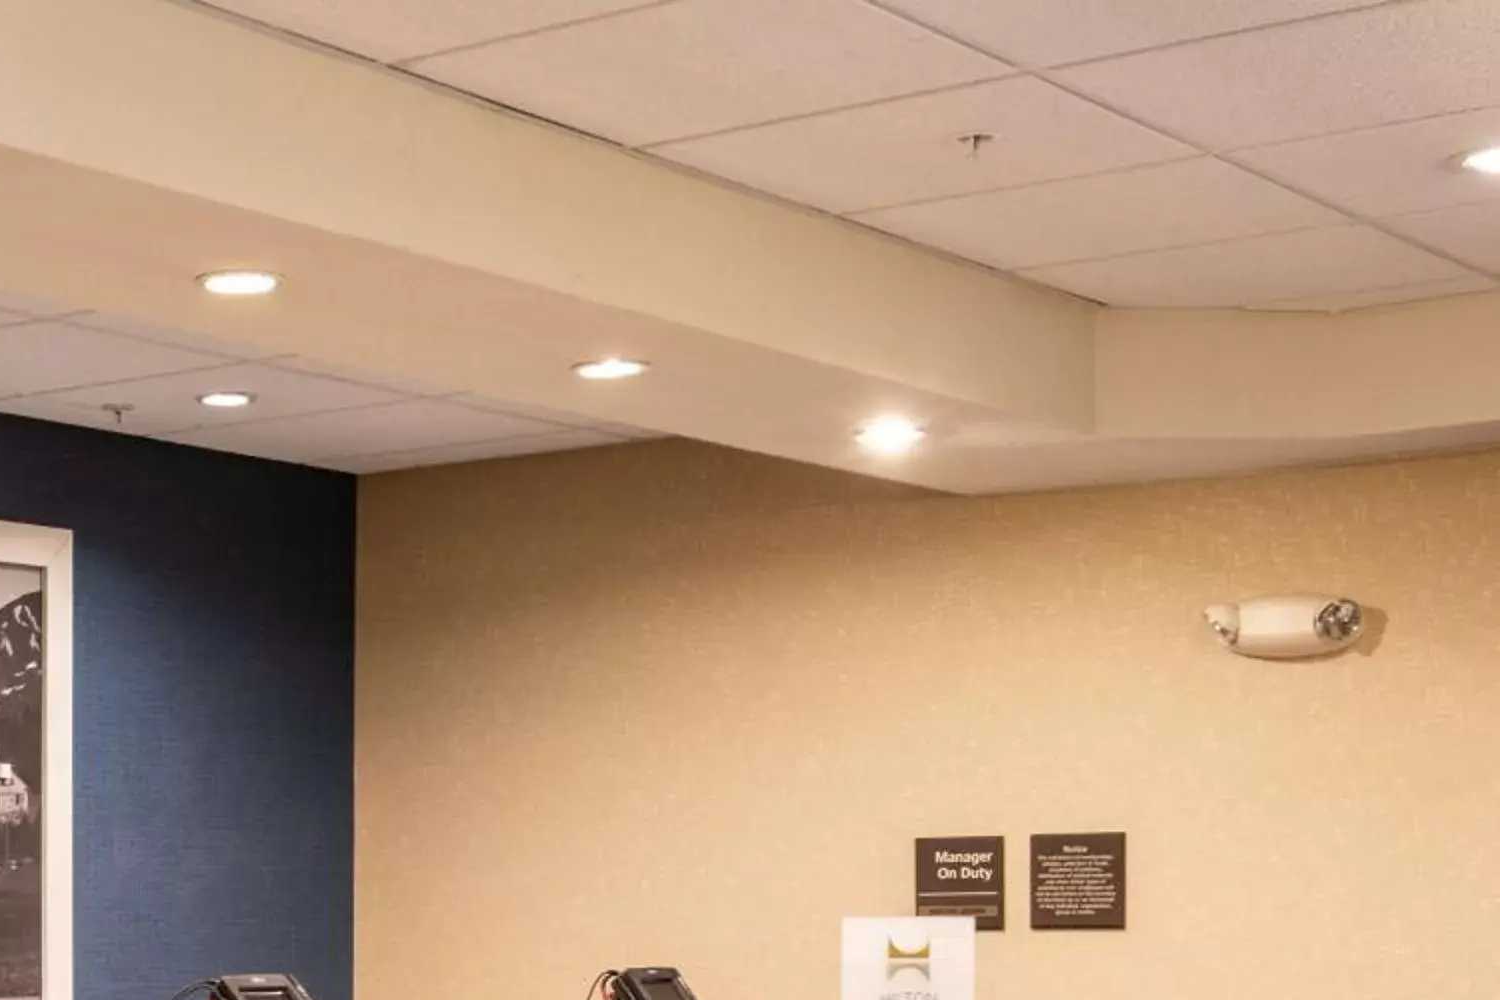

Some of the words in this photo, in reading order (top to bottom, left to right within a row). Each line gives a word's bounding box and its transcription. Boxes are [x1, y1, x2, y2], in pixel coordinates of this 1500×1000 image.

[935, 850, 995, 866] Manager
[937, 867, 957, 880] On
[961, 866, 993, 882] Duty
